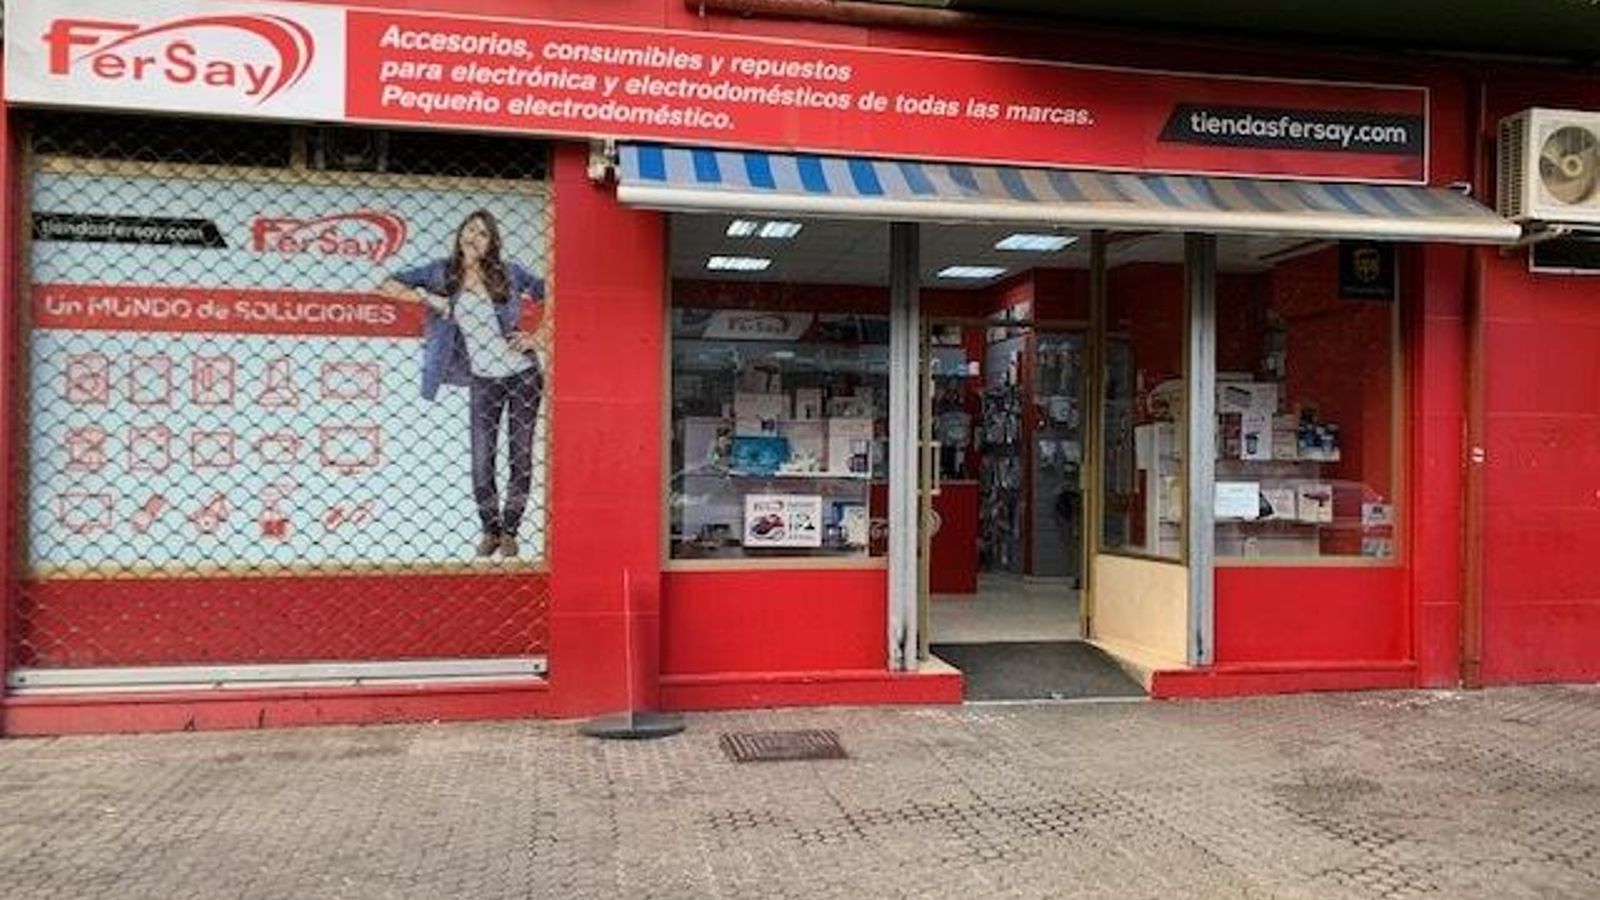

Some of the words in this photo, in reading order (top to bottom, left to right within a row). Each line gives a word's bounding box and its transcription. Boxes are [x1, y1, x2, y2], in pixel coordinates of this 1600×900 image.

[42, 18, 280, 98] FerSay
[380, 24, 533, 59] Accesorios,
[543, 41, 702, 70] consumibles
[709, 56, 724, 76] y
[730, 56, 852, 82] repuestos
[380, 61, 442, 82] para
[451, 62, 596, 91] electrónica
[603, 75, 619, 96] y
[625, 74, 852, 110] electrodomésticos
[857, 91, 888, 112] de
[895, 94, 959, 117] todas
[966, 97, 1000, 119] las
[1006, 102, 1095, 126] marcas.
[382, 85, 500, 113] Pequeño
[508, 94, 735, 130] electrodoméstico.
[1190, 111, 1407, 148] tiendasfersay.com
[41, 219, 202, 241] tiendasfersay.com
[250, 216, 390, 263] FerSay
[45, 295, 81, 316] Un
[87, 297, 191, 319] MUNDO
[196, 302, 229, 321] de
[234, 303, 397, 326] SOLUCIONES
